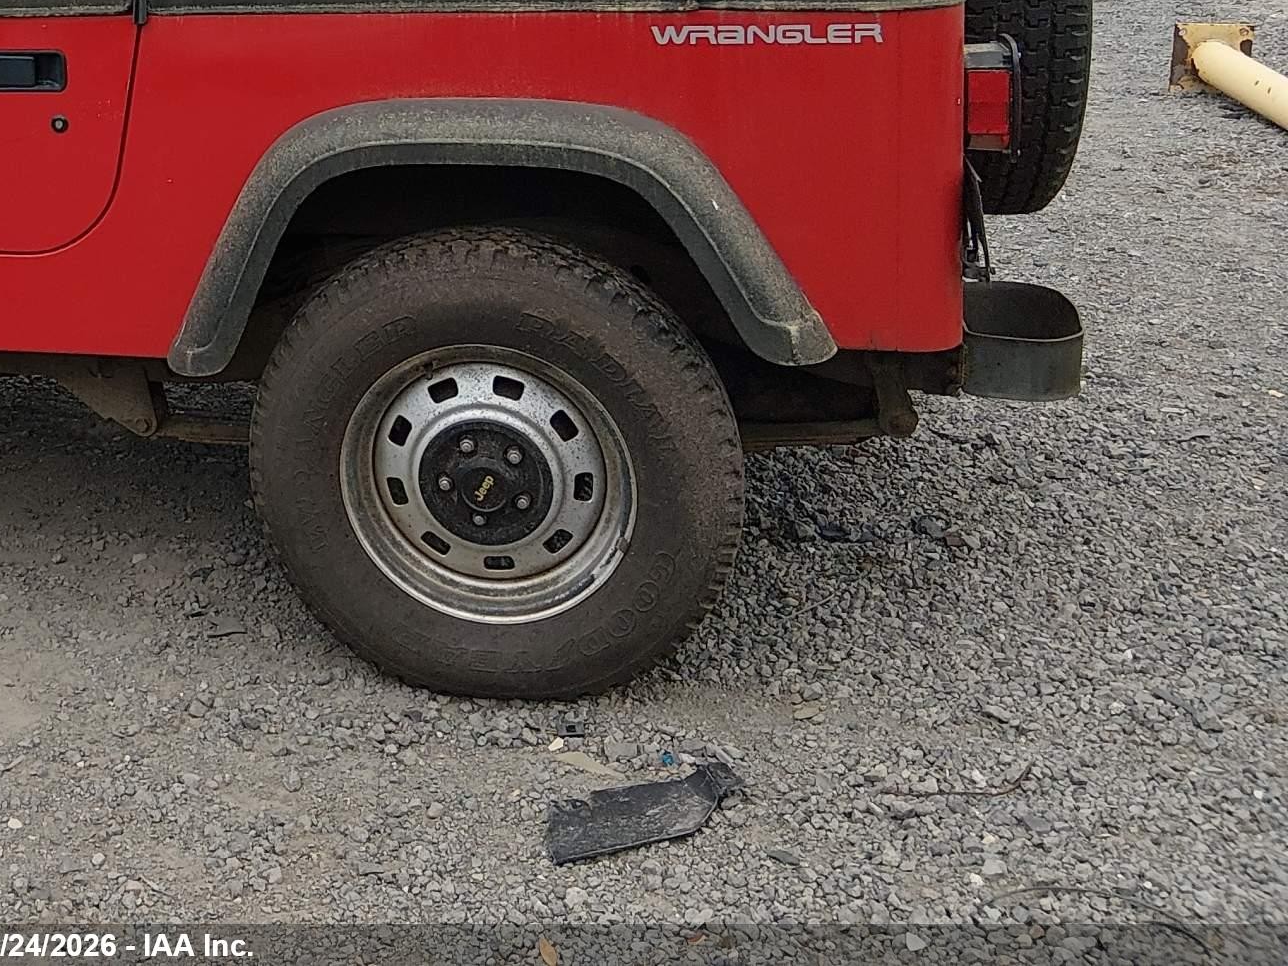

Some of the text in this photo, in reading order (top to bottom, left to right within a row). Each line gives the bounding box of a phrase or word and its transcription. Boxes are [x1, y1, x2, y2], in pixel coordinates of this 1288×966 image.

[650, 23, 884, 45] WRANGLER
[474, 475, 495, 502] Jeep
[393, 550, 678, 674] GOODYEAR
